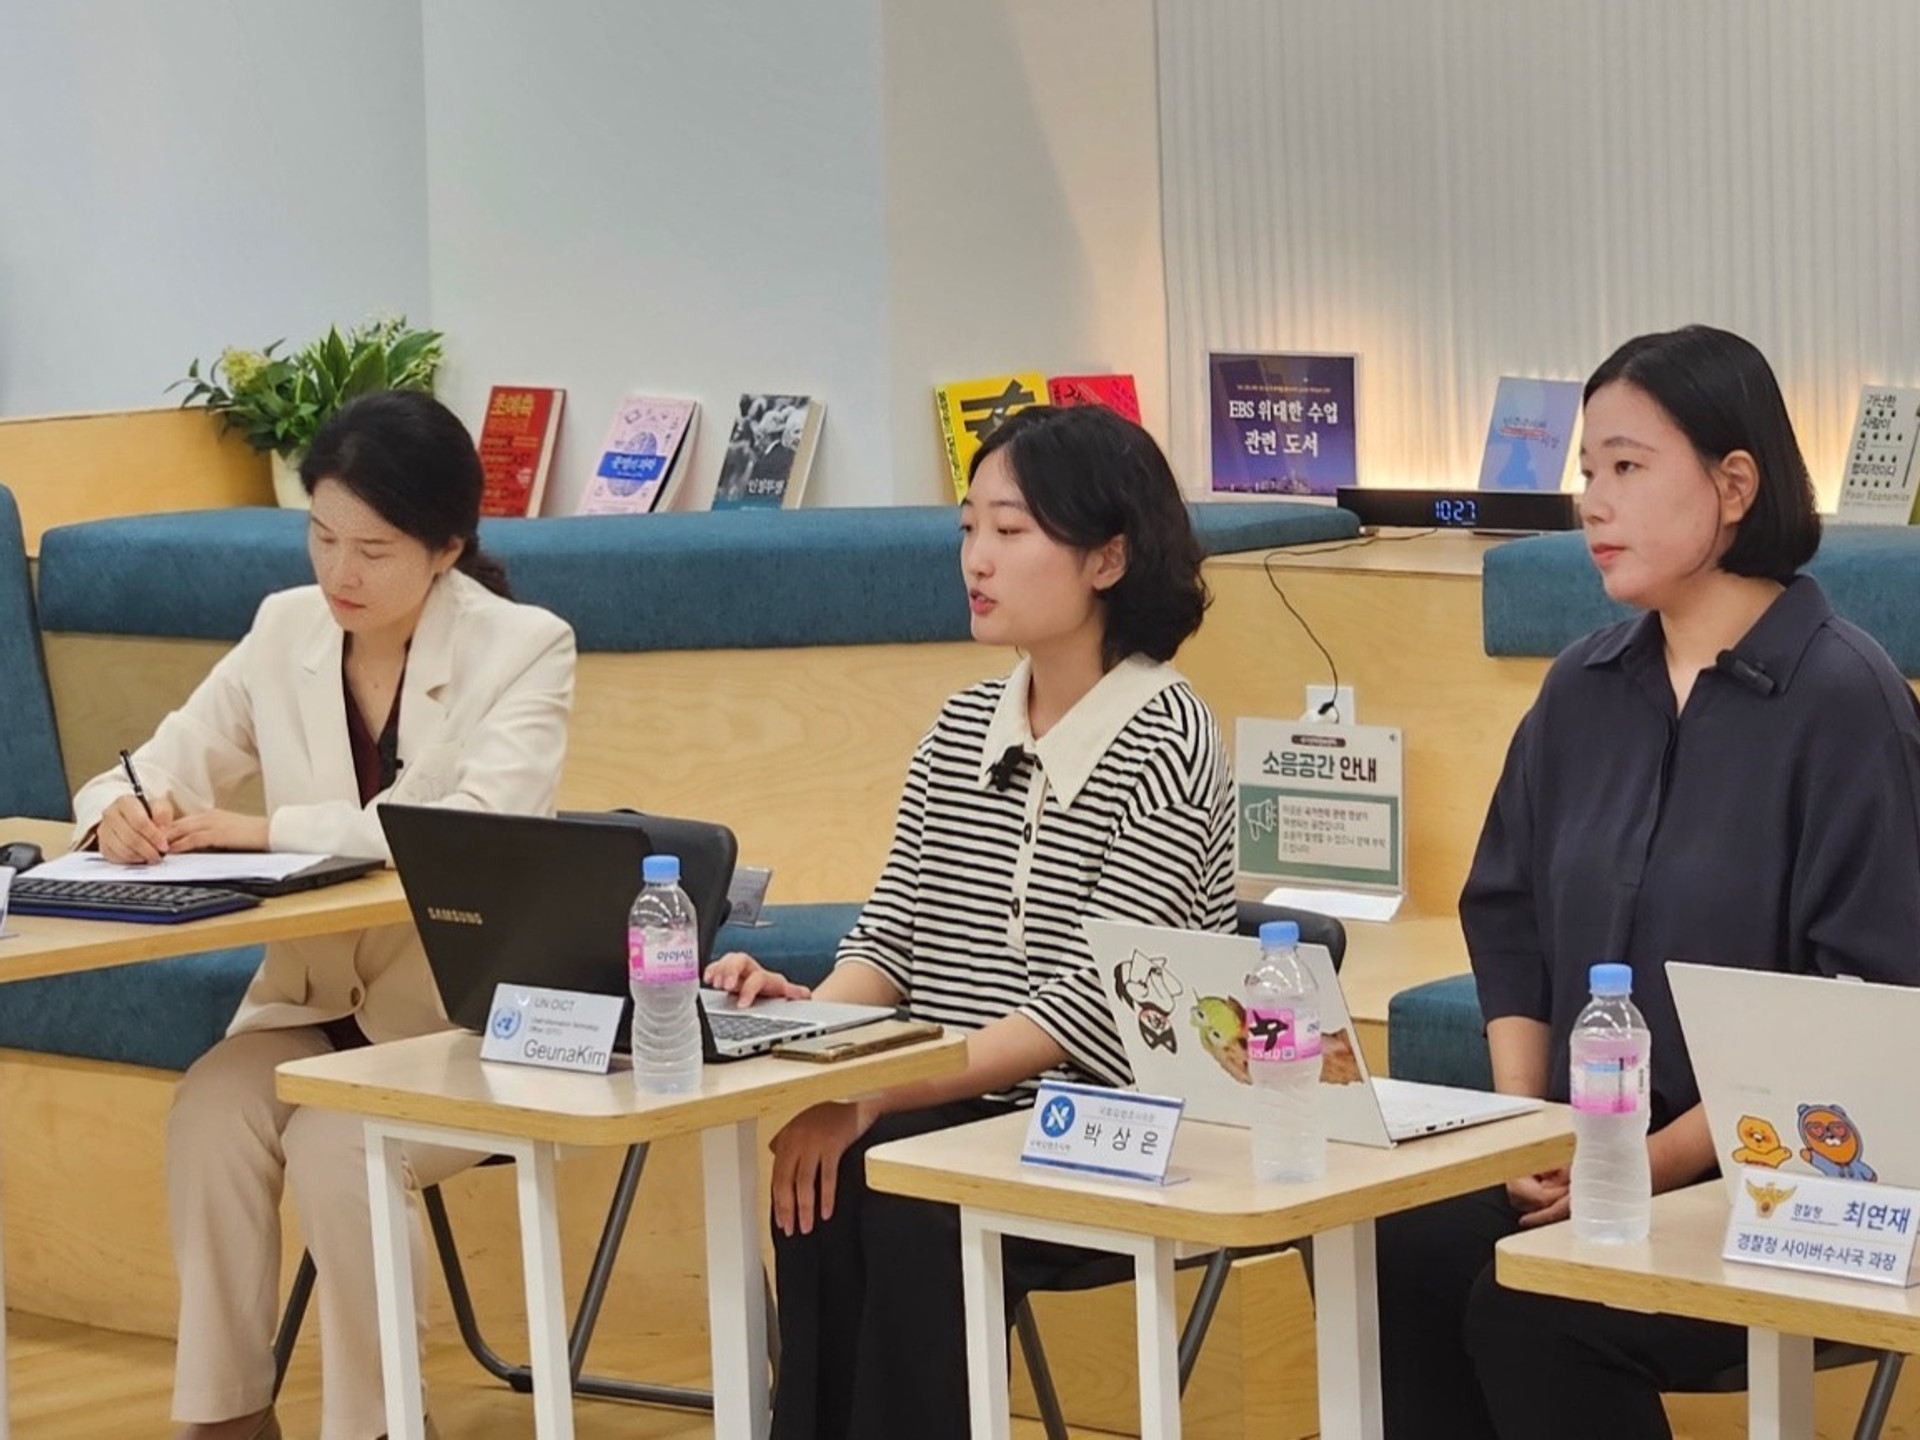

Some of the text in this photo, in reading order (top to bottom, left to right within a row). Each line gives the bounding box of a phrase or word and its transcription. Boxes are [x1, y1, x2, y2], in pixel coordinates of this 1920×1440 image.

[1229, 399, 1338, 424] EBS 위대한 수업
[1244, 428, 1318, 458] 관련 도서
[1262, 750, 1377, 783] 소음공간 안내
[427, 906, 483, 926] SAMSUNG
[524, 1039, 607, 1067] GeunaKim
[1084, 1122, 1101, 1147] 박
[1112, 1127, 1131, 1152] 상
[1140, 1130, 1158, 1156] 은
[1842, 1200, 1911, 1236] 최연재
[1737, 1231, 1897, 1272] 경찰청 사이버수사국 과장
